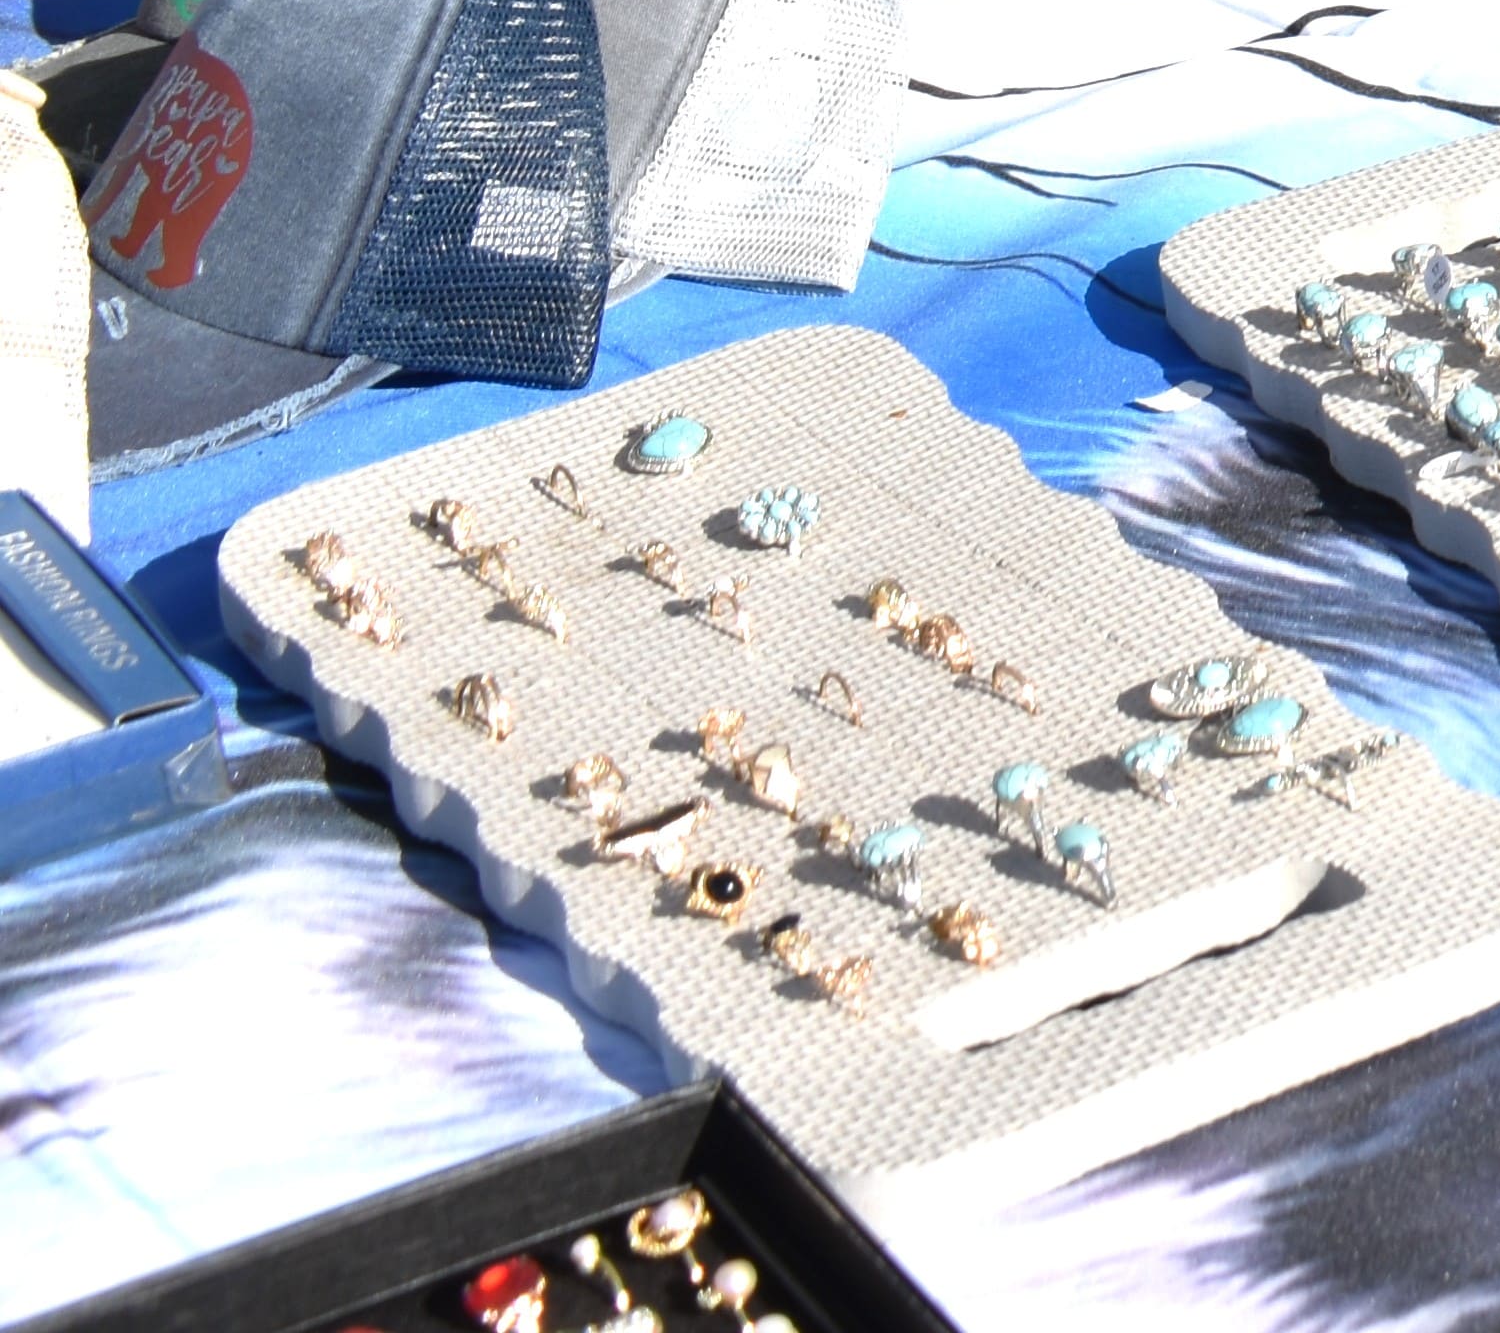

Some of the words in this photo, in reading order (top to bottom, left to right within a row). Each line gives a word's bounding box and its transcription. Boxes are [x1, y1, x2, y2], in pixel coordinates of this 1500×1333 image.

[155, 64, 248, 148] Papa
[0, 530, 84, 618] FASHION
[63, 600, 139, 673] RINGS
